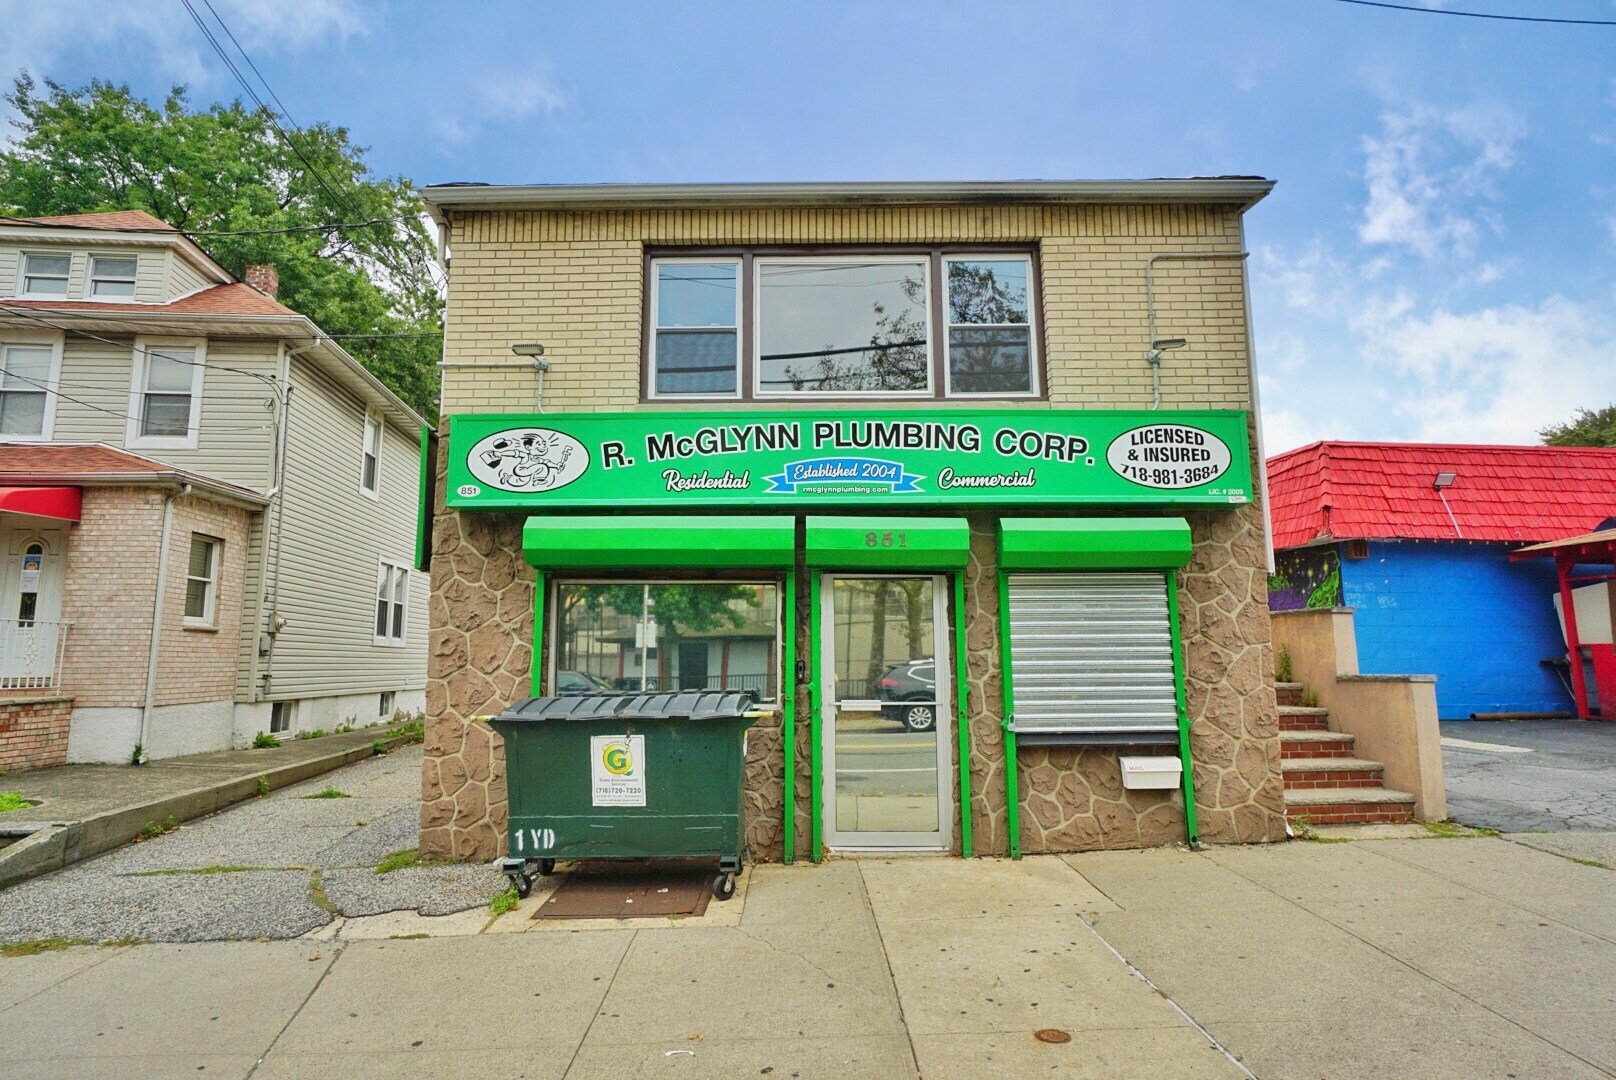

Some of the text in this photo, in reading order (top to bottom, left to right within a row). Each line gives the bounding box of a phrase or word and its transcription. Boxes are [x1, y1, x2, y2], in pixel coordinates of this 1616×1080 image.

[602, 421, 1095, 469] R. McGLYNN PLUMBING CORP.
[1131, 428, 1205, 446] LICENSED
[1127, 447, 1211, 462] & INSURED
[662, 468, 750, 492] Residential
[793, 462, 897, 480] Established 2004
[937, 467, 1036, 490] Commercial
[1120, 463, 1219, 485] 718-981-3684
[460, 486, 478, 496] 851
[802, 485, 889, 494] rmcglynnplumbing.com
[865, 531, 907, 548] 851
[515, 828, 555, 852] 1 YD
